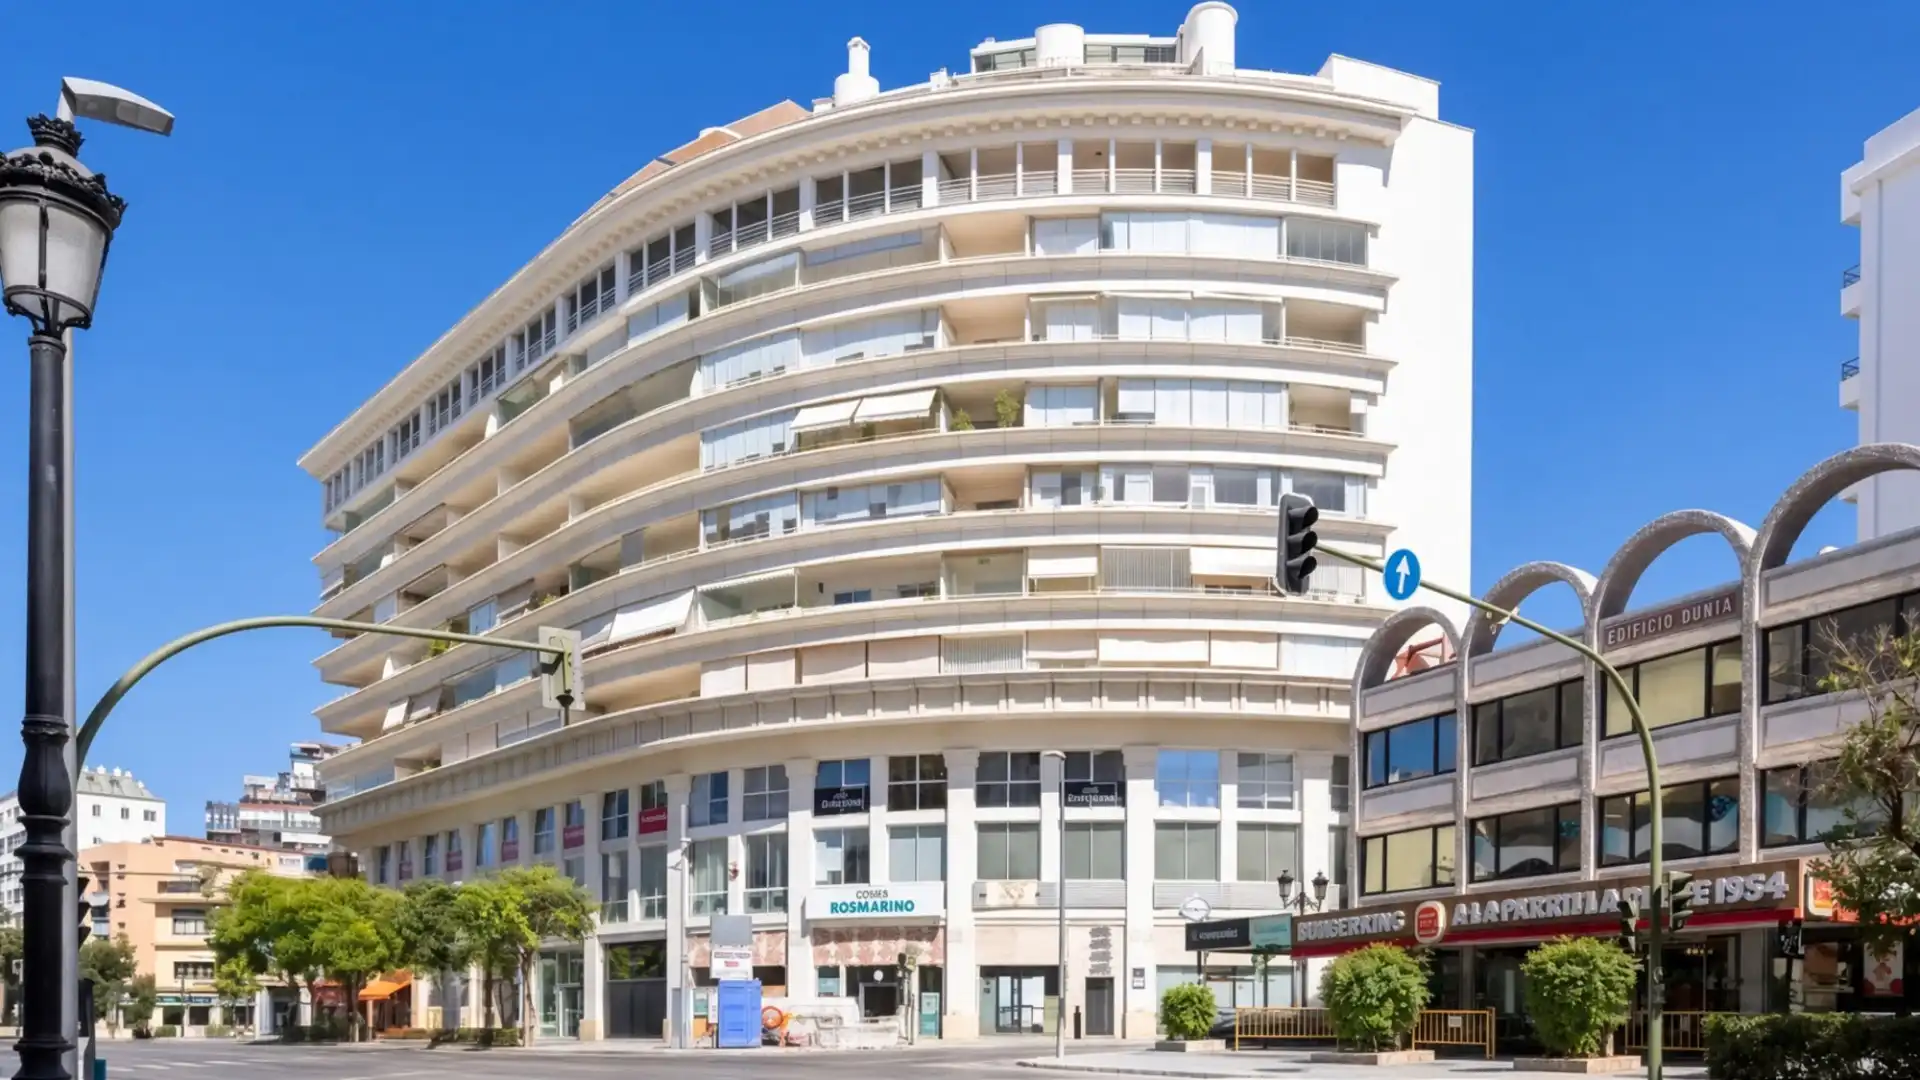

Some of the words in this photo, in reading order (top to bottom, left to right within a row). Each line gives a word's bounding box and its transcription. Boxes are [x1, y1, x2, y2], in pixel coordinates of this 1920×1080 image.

[1607, 614, 1673, 645] EDIFICIO
[1682, 597, 1732, 624] DUNIA
[1715, 871, 1790, 905] 1954
[830, 900, 915, 914] ROSMARINO
